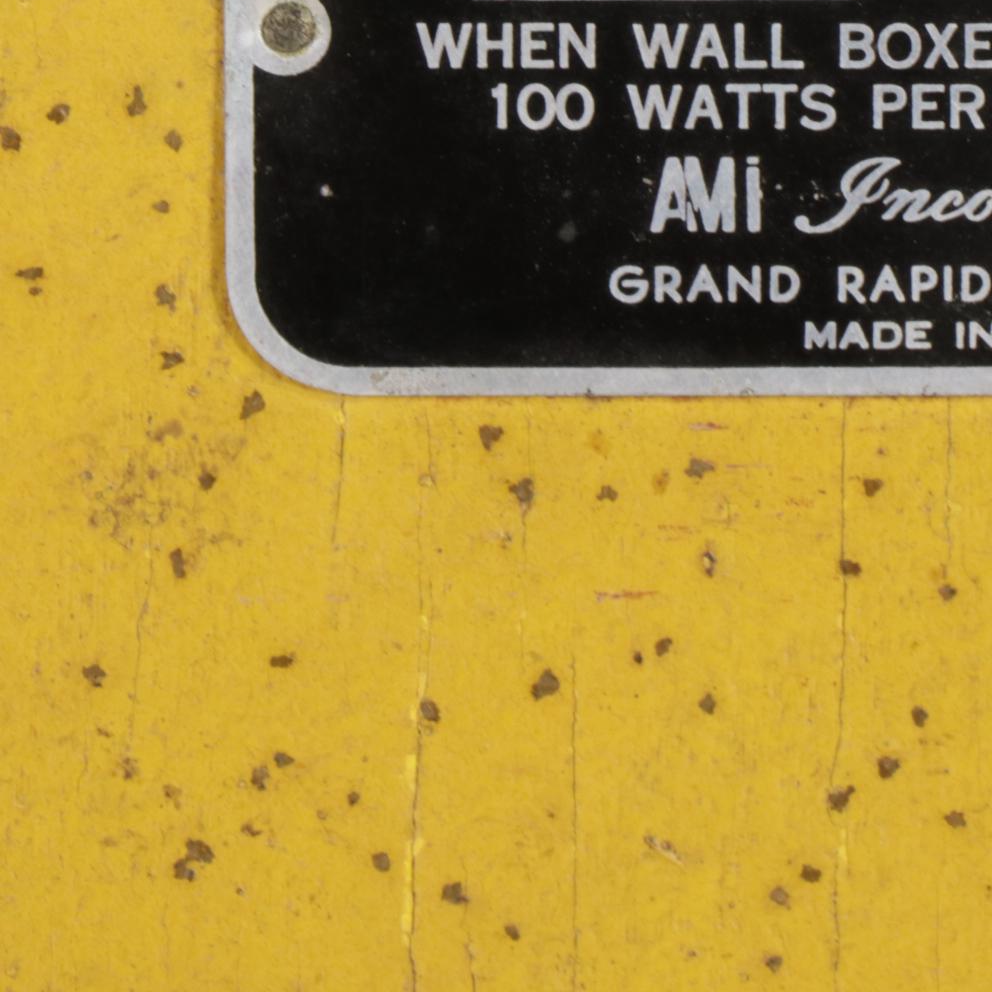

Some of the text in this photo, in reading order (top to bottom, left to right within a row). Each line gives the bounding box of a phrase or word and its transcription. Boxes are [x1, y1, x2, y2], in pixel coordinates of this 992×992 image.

[415, 22, 597, 70] WHEN
[632, 22, 805, 70] WALL
[491, 83, 596, 131] 100
[627, 83, 837, 131] WATTS
[872, 82, 986, 130] PER
[608, 264, 802, 305] GRAND
[803, 320, 933, 351] MADE
